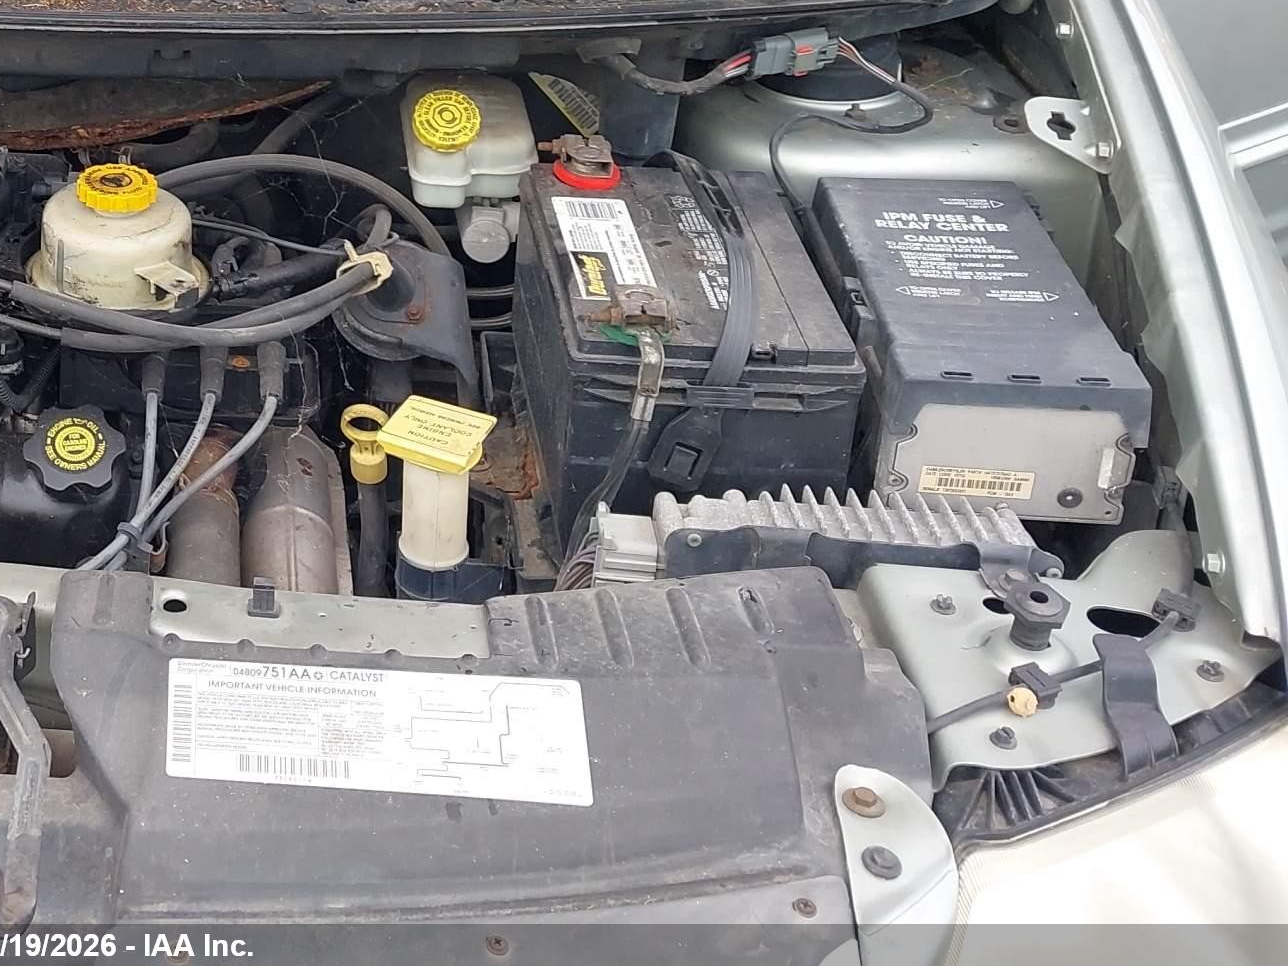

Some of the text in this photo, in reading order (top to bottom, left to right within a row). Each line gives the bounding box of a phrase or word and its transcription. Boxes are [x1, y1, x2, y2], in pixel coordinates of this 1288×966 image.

[882, 211, 987, 224] IPM FUSE &
[874, 219, 1010, 232] RELAY CENTER
[903, 234, 988, 245] CAUTION!
[47, 417, 100, 437] ENGINE OIL
[402, 414, 472, 437] COOLANT ONLY
[416, 423, 452, 438] ENGINE
[407, 430, 449, 445] CAUTION
[44, 440, 106, 471] SEE OWNERS MANUAL
[329, 670, 385, 683] CATALYST
[208, 680, 377, 698] IMPORTANT VEHICLE INFORMATION
